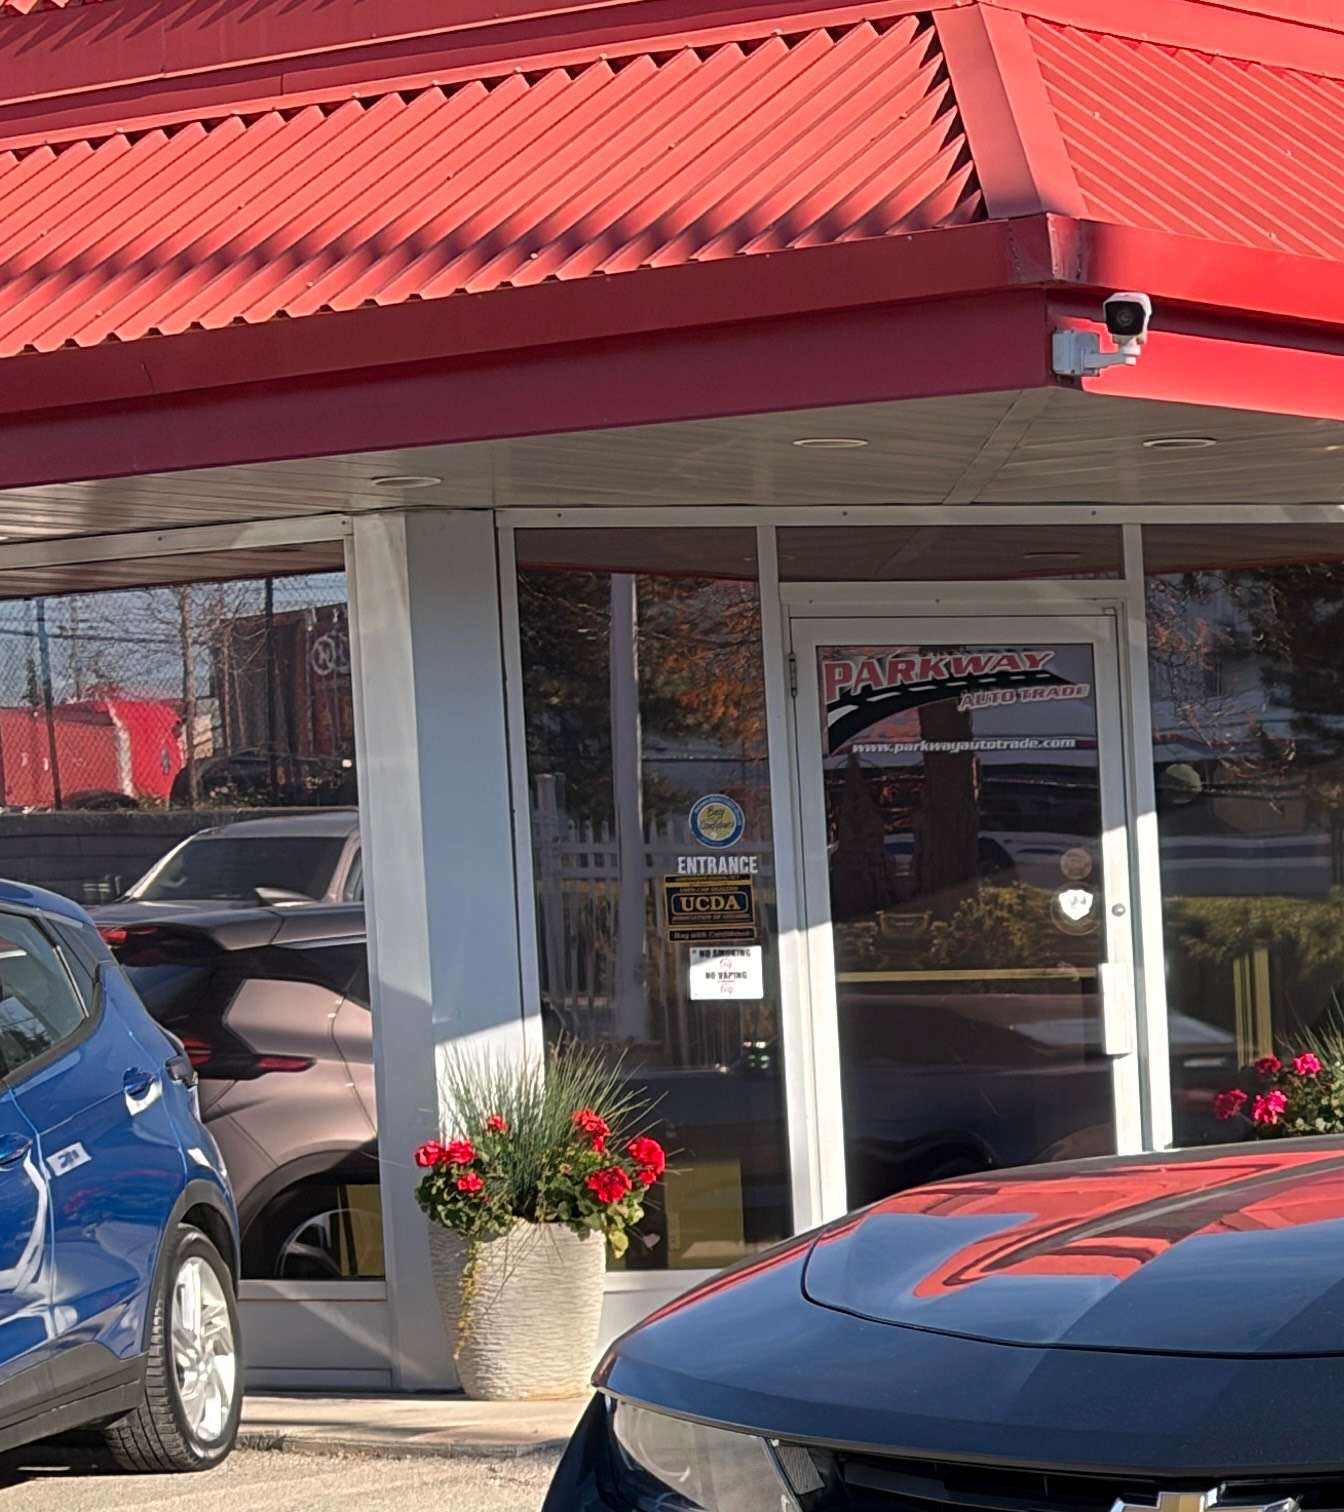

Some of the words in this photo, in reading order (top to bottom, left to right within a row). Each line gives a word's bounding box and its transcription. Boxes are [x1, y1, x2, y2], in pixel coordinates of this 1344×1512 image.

[823, 651, 1055, 704] PARKWAY
[957, 688, 1016, 711] AUTO
[1020, 683, 1090, 703] TRADE
[852, 737, 1077, 754] www.parkwayautotrade.com
[677, 855, 759, 874] ENTRANCE
[679, 895, 741, 912] UCDA
